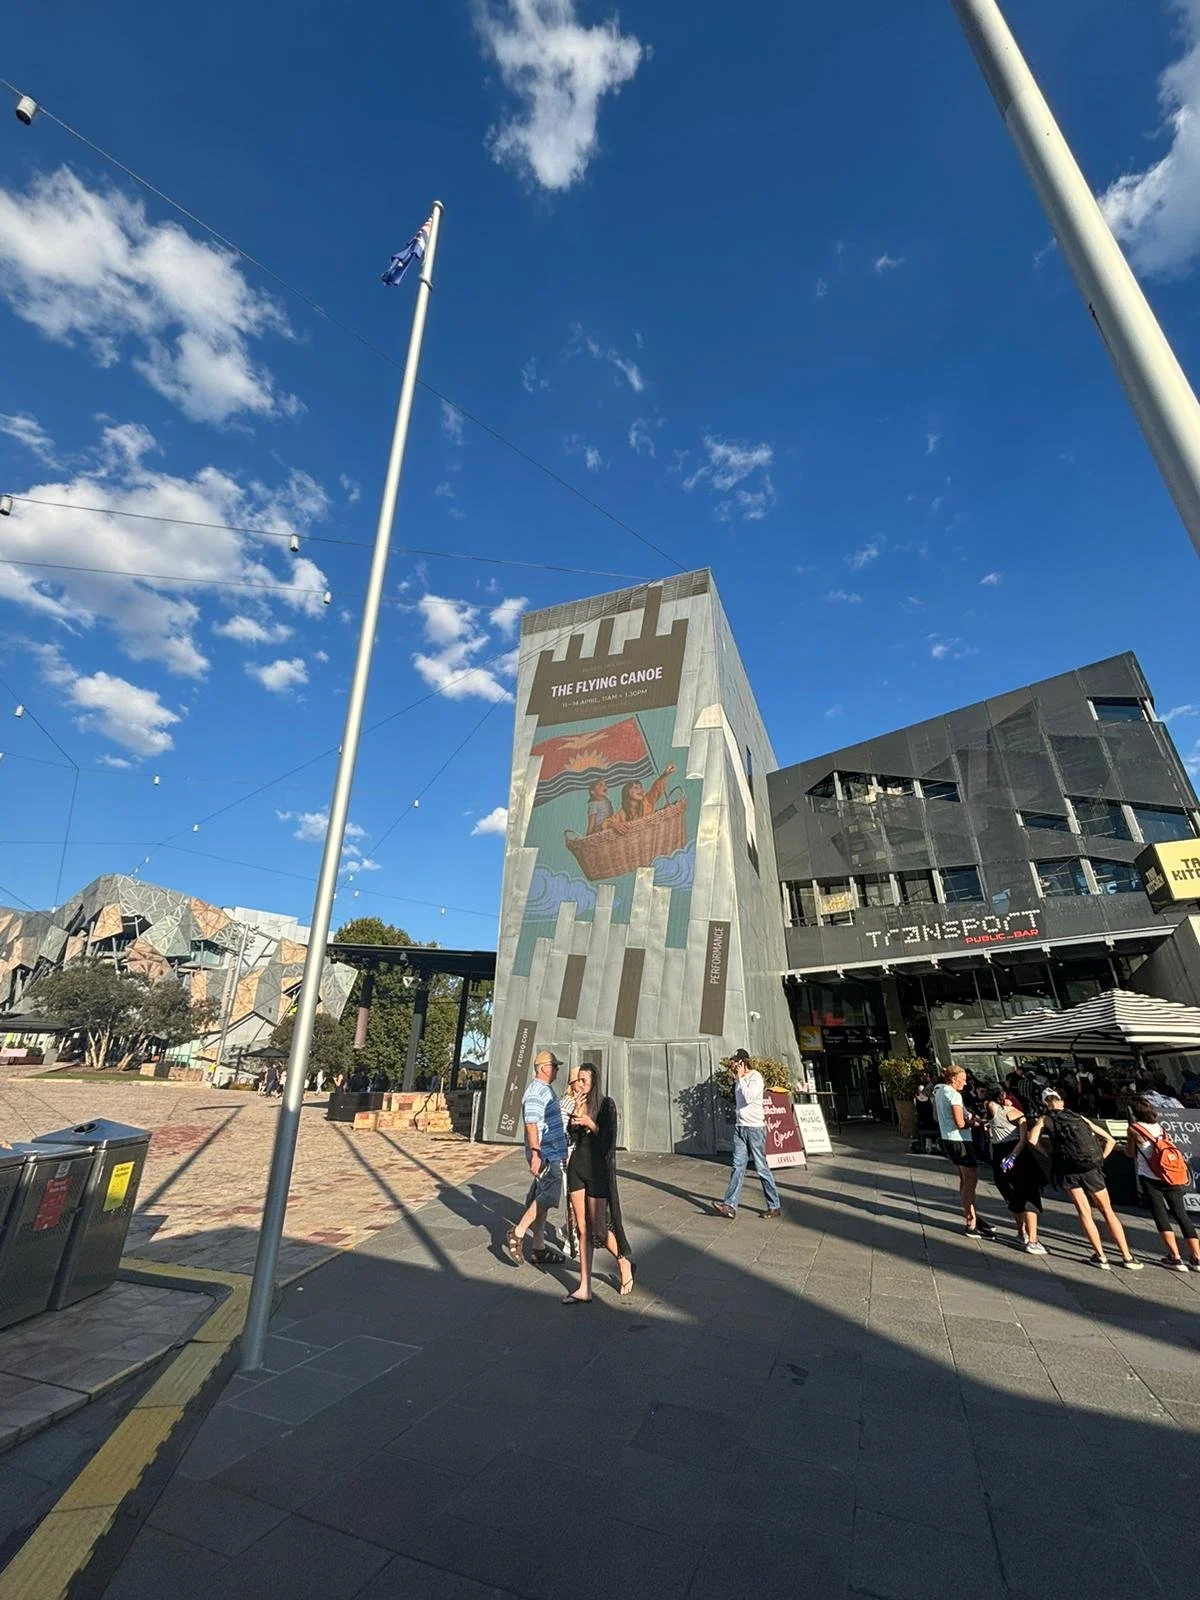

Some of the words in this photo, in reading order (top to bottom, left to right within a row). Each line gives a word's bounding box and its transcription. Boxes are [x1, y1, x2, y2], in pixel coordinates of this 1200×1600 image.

[551, 683, 574, 698] THE
[576, 676, 617, 694] FLYING
[620, 666, 663, 685] CANOE
[710, 927, 724, 984] PERFORMANCE
[500, 1113, 510, 1130] FED
[799, 1116, 821, 1124] MUSIC
[773, 1130, 794, 1148] Open
